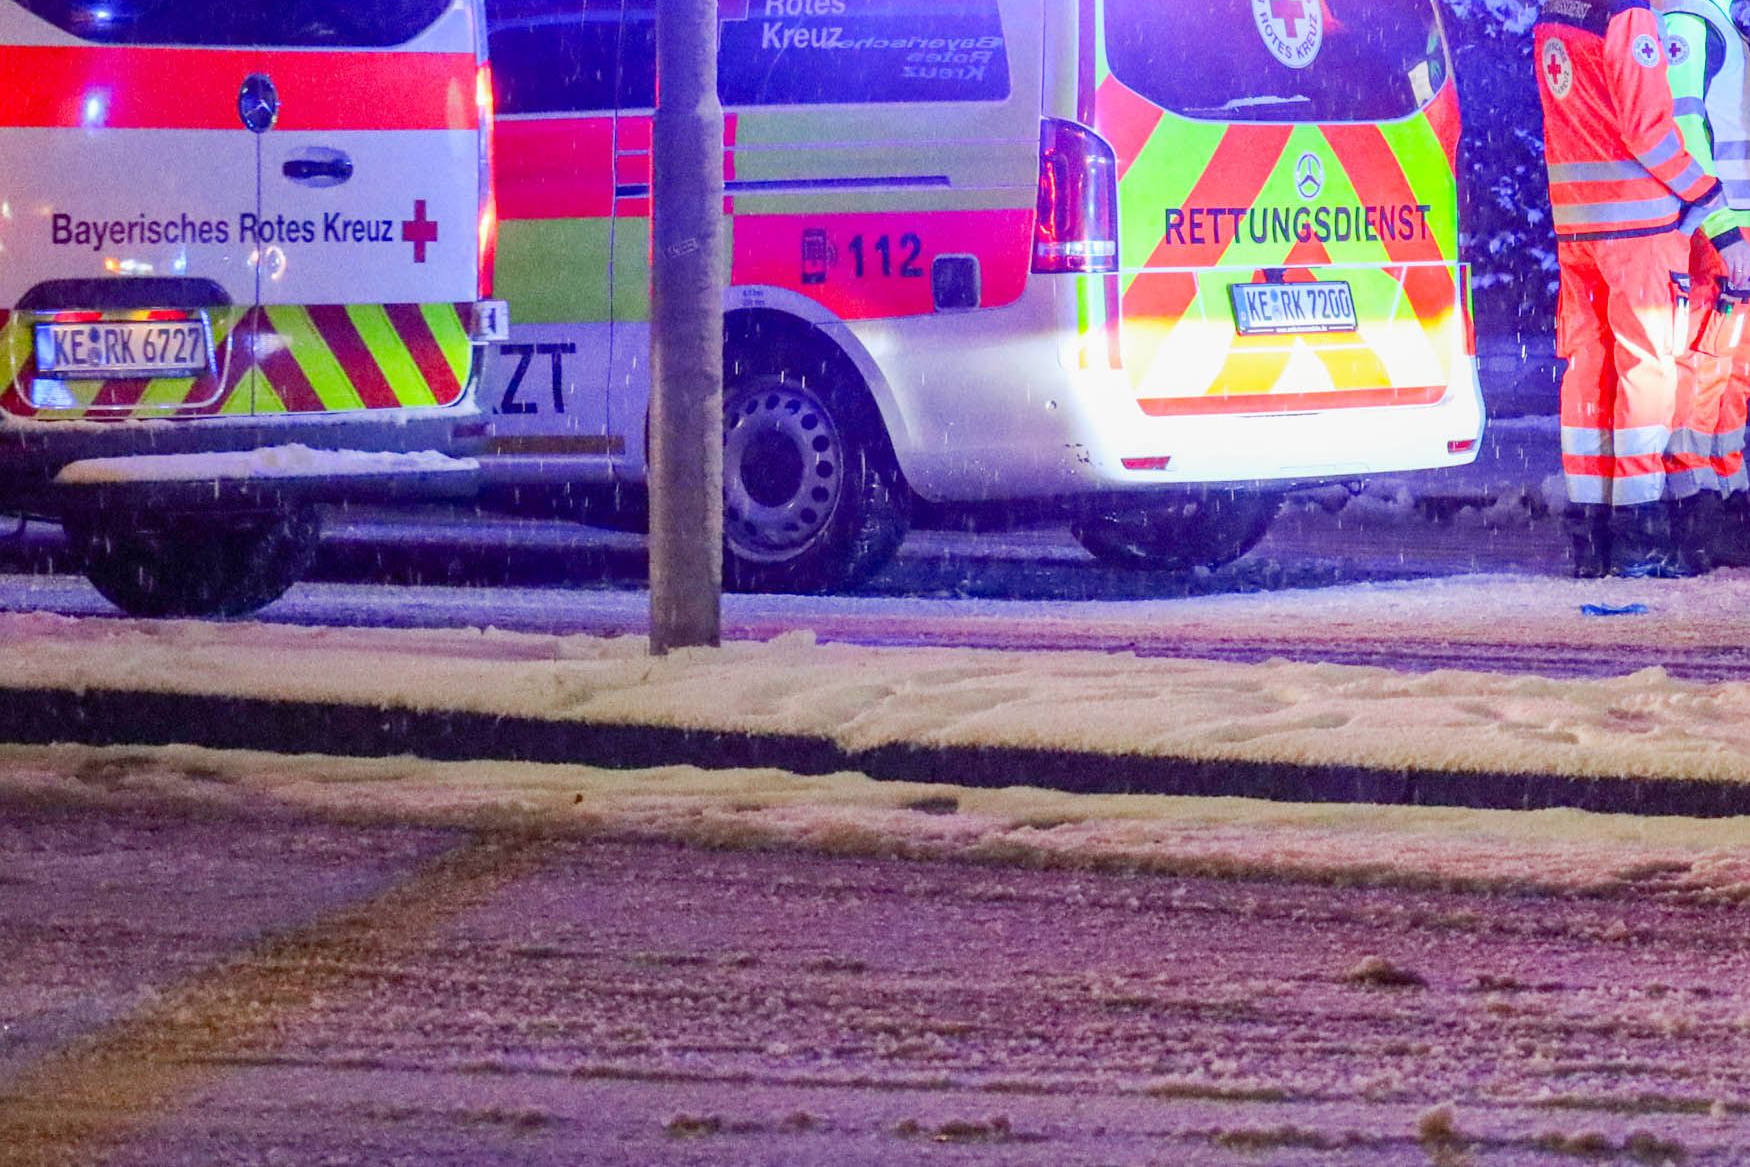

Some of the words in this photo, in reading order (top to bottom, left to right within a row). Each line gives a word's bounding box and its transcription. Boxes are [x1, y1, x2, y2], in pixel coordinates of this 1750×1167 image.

[761, 21, 843, 49] Kreuz
[1259, 12, 1292, 59] ROTES
[1295, 13, 1318, 59] KREUZ
[52, 213, 229, 251] Bayerisches
[239, 212, 315, 243] Rotes
[323, 212, 393, 243] Kreuz
[1164, 204, 1431, 245] RETTUNGSDIENST
[849, 232, 924, 277] 112
[1247, 290, 1272, 321] KE
[1280, 290, 1305, 321] RK
[1307, 288, 1351, 319] 7200
[54, 329, 87, 366] KE
[105, 328, 135, 365] RK
[143, 327, 200, 364] 6727
[493, 343, 576, 414] ZT
